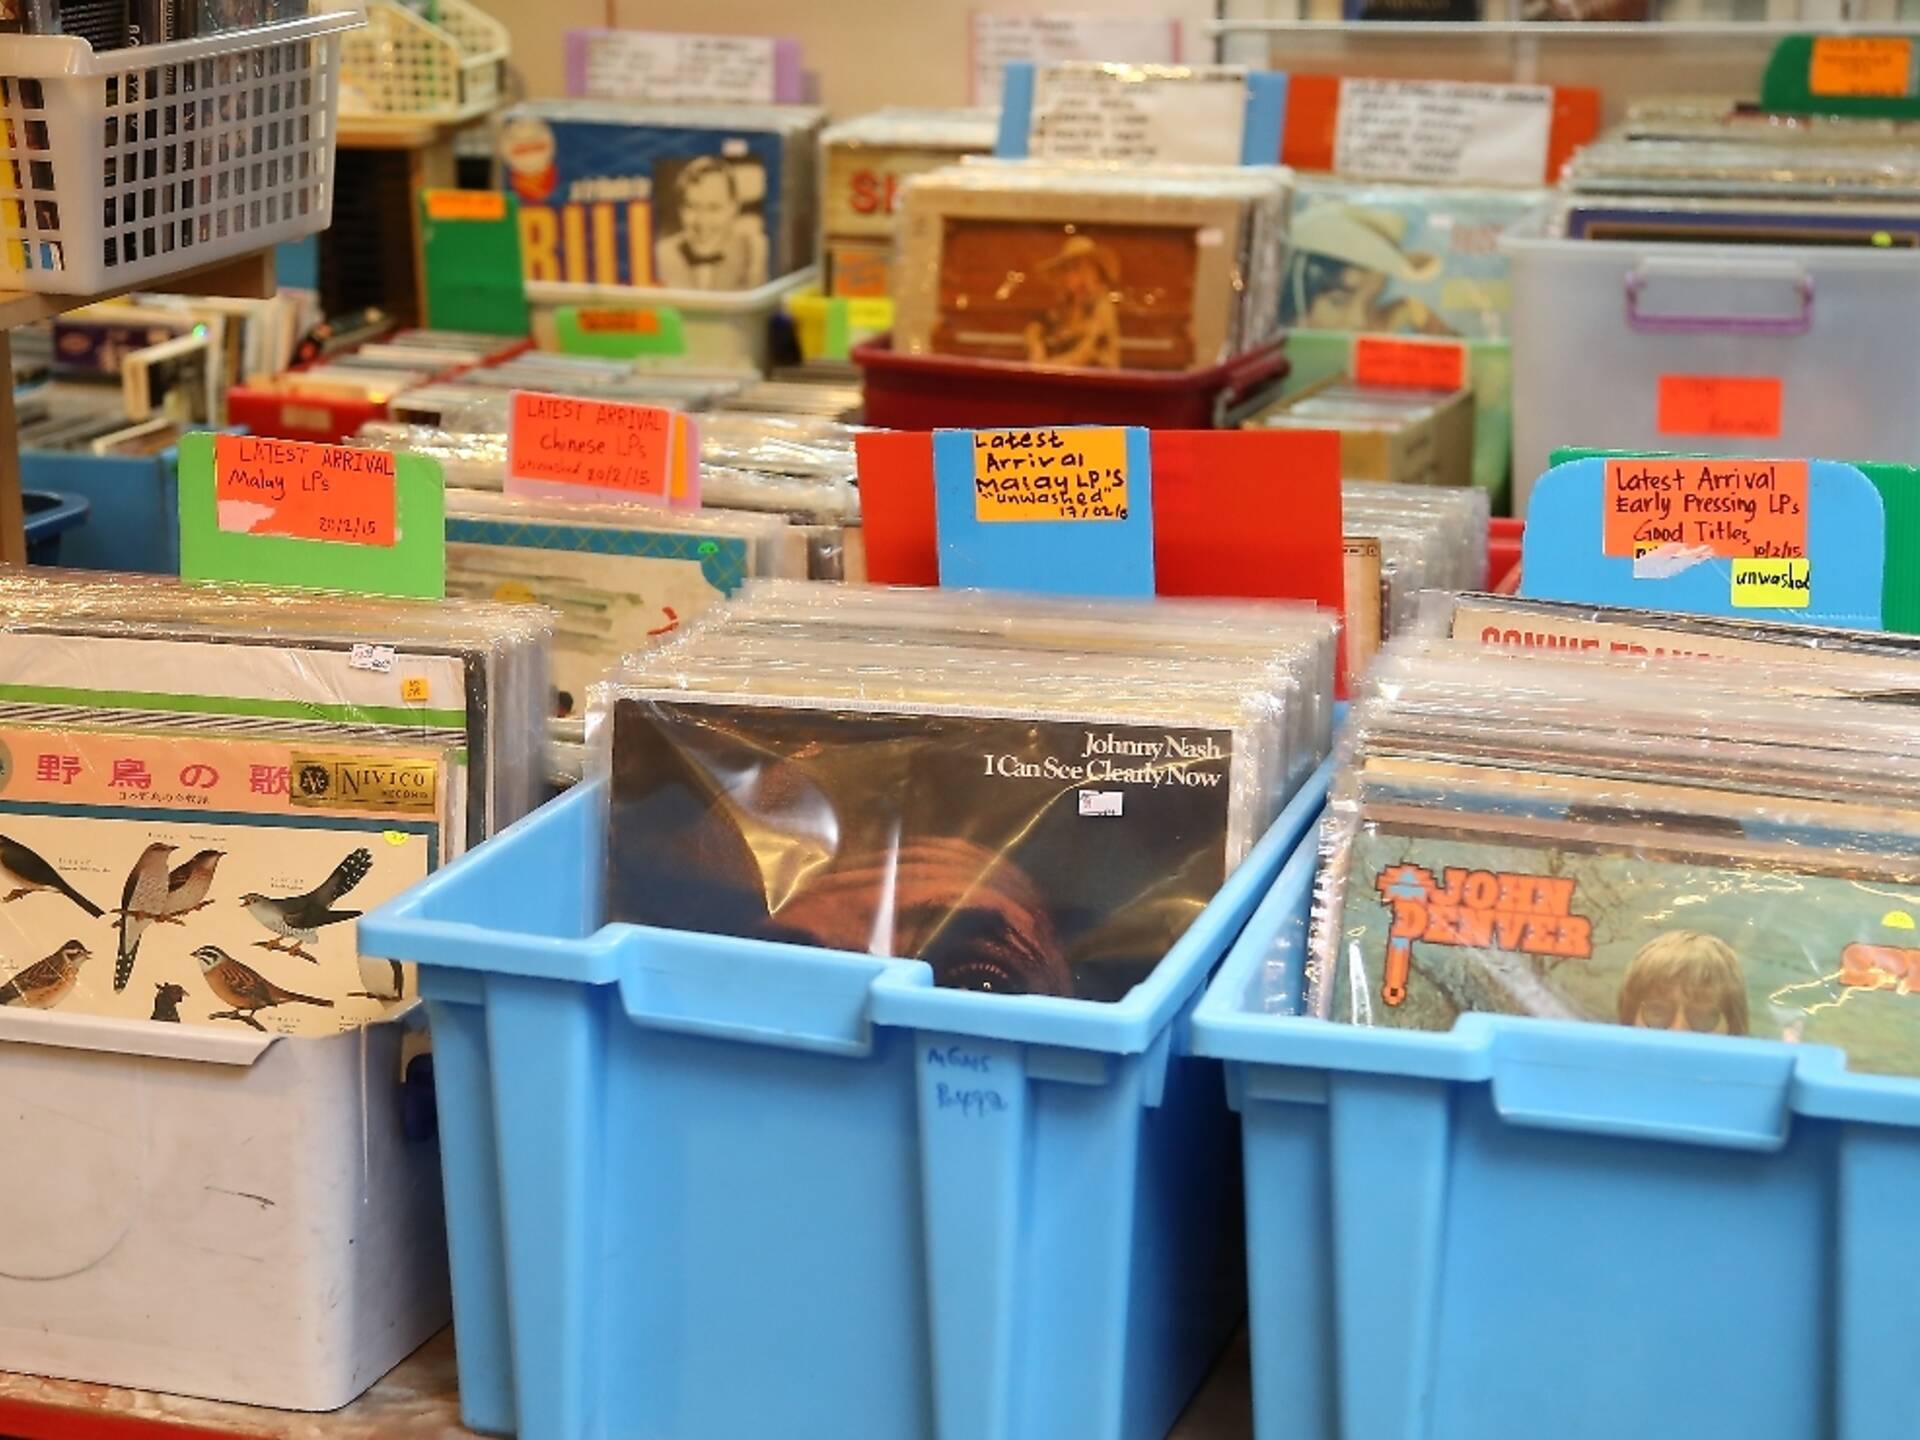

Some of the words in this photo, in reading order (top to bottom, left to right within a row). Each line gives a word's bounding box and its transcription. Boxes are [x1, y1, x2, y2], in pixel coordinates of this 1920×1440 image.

[527, 400, 582, 421] LATEST
[596, 404, 661, 431] ARRIVAL
[540, 427, 605, 454] Chinese
[975, 430, 1064, 449] Latest
[240, 442, 309, 464] LATEST
[322, 449, 394, 476] ARRIVAL
[987, 453, 1084, 473] Arrival
[228, 469, 286, 501] Malay
[302, 470, 330, 491] LPs
[1616, 467, 1685, 491] Latest
[1698, 467, 1775, 491] Arrival
[1616, 492, 1671, 520] Early
[1684, 492, 1757, 522] Pressing
[1769, 494, 1801, 515] LPs
[1633, 519, 1684, 543] Good
[1694, 520, 1751, 544] Titles
[1081, 731, 1163, 760] Johnny
[1164, 735, 1221, 759] Nash
[341, 769, 425, 795] NIVICO
[984, 755, 993, 776] I
[997, 755, 1041, 778] Can
[1043, 756, 1083, 779] See
[1086, 759, 1164, 788] Clearly
[1166, 767, 1222, 787] Now
[1427, 866, 1576, 915] JOHN
[1391, 899, 1593, 960] DENVER
